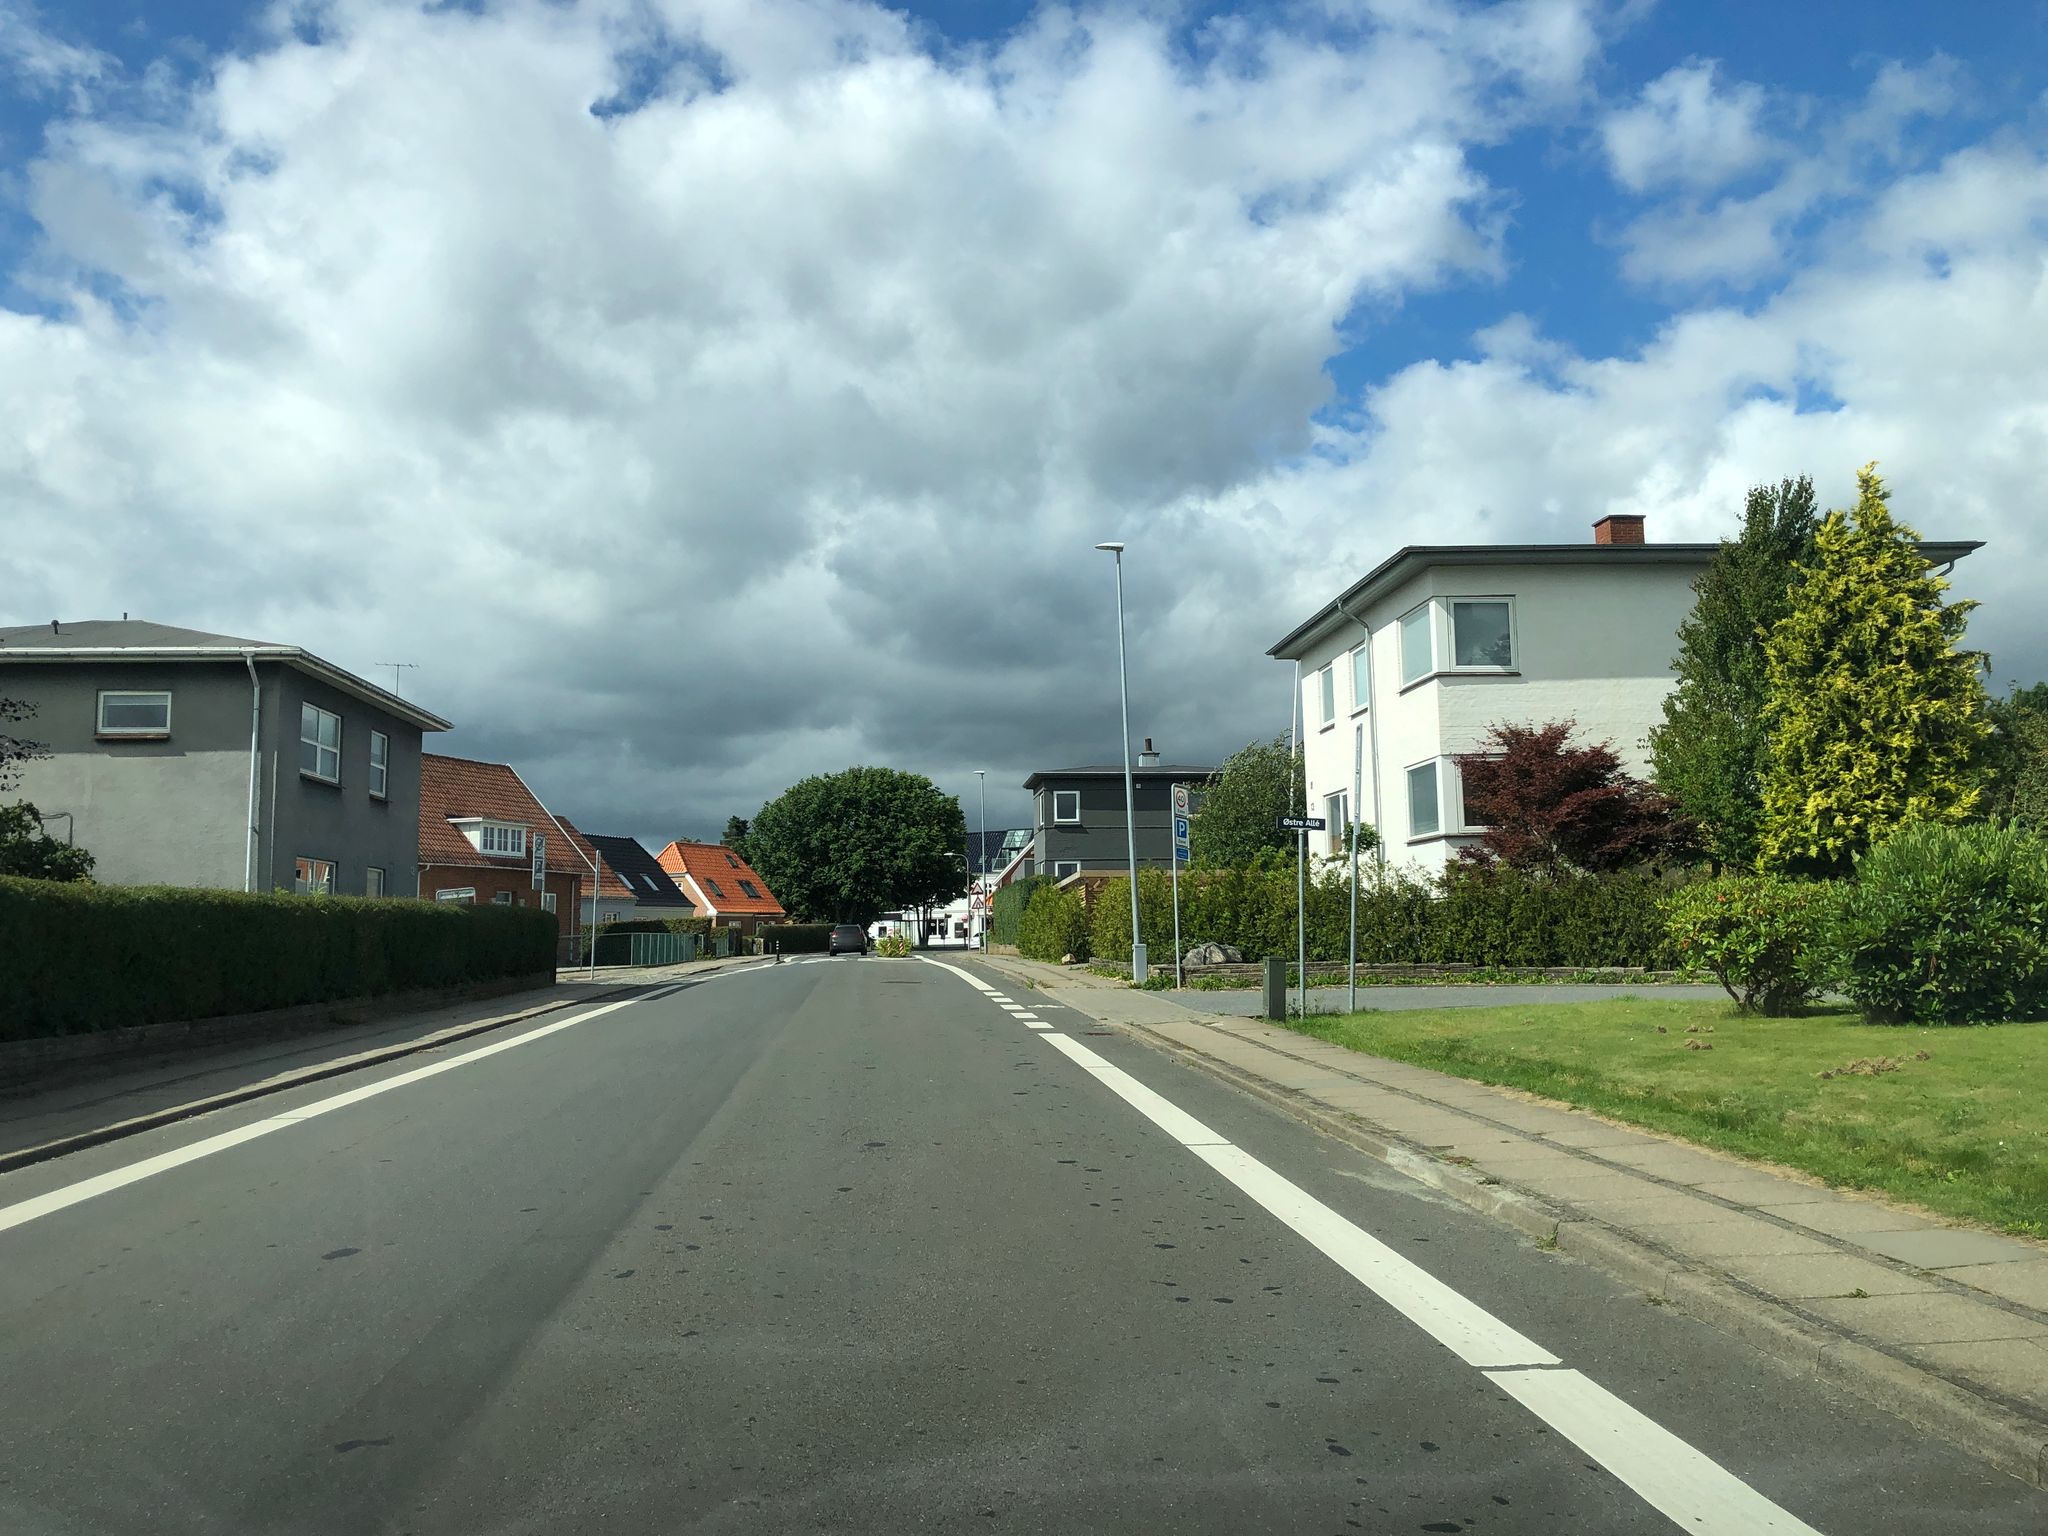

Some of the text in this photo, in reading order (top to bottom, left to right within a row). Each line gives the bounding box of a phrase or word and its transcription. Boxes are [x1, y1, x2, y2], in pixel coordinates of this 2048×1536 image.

[1178, 795, 1185, 803] 40
[1283, 818, 1320, 827] Østre Allé
[1179, 821, 1186, 836] P
